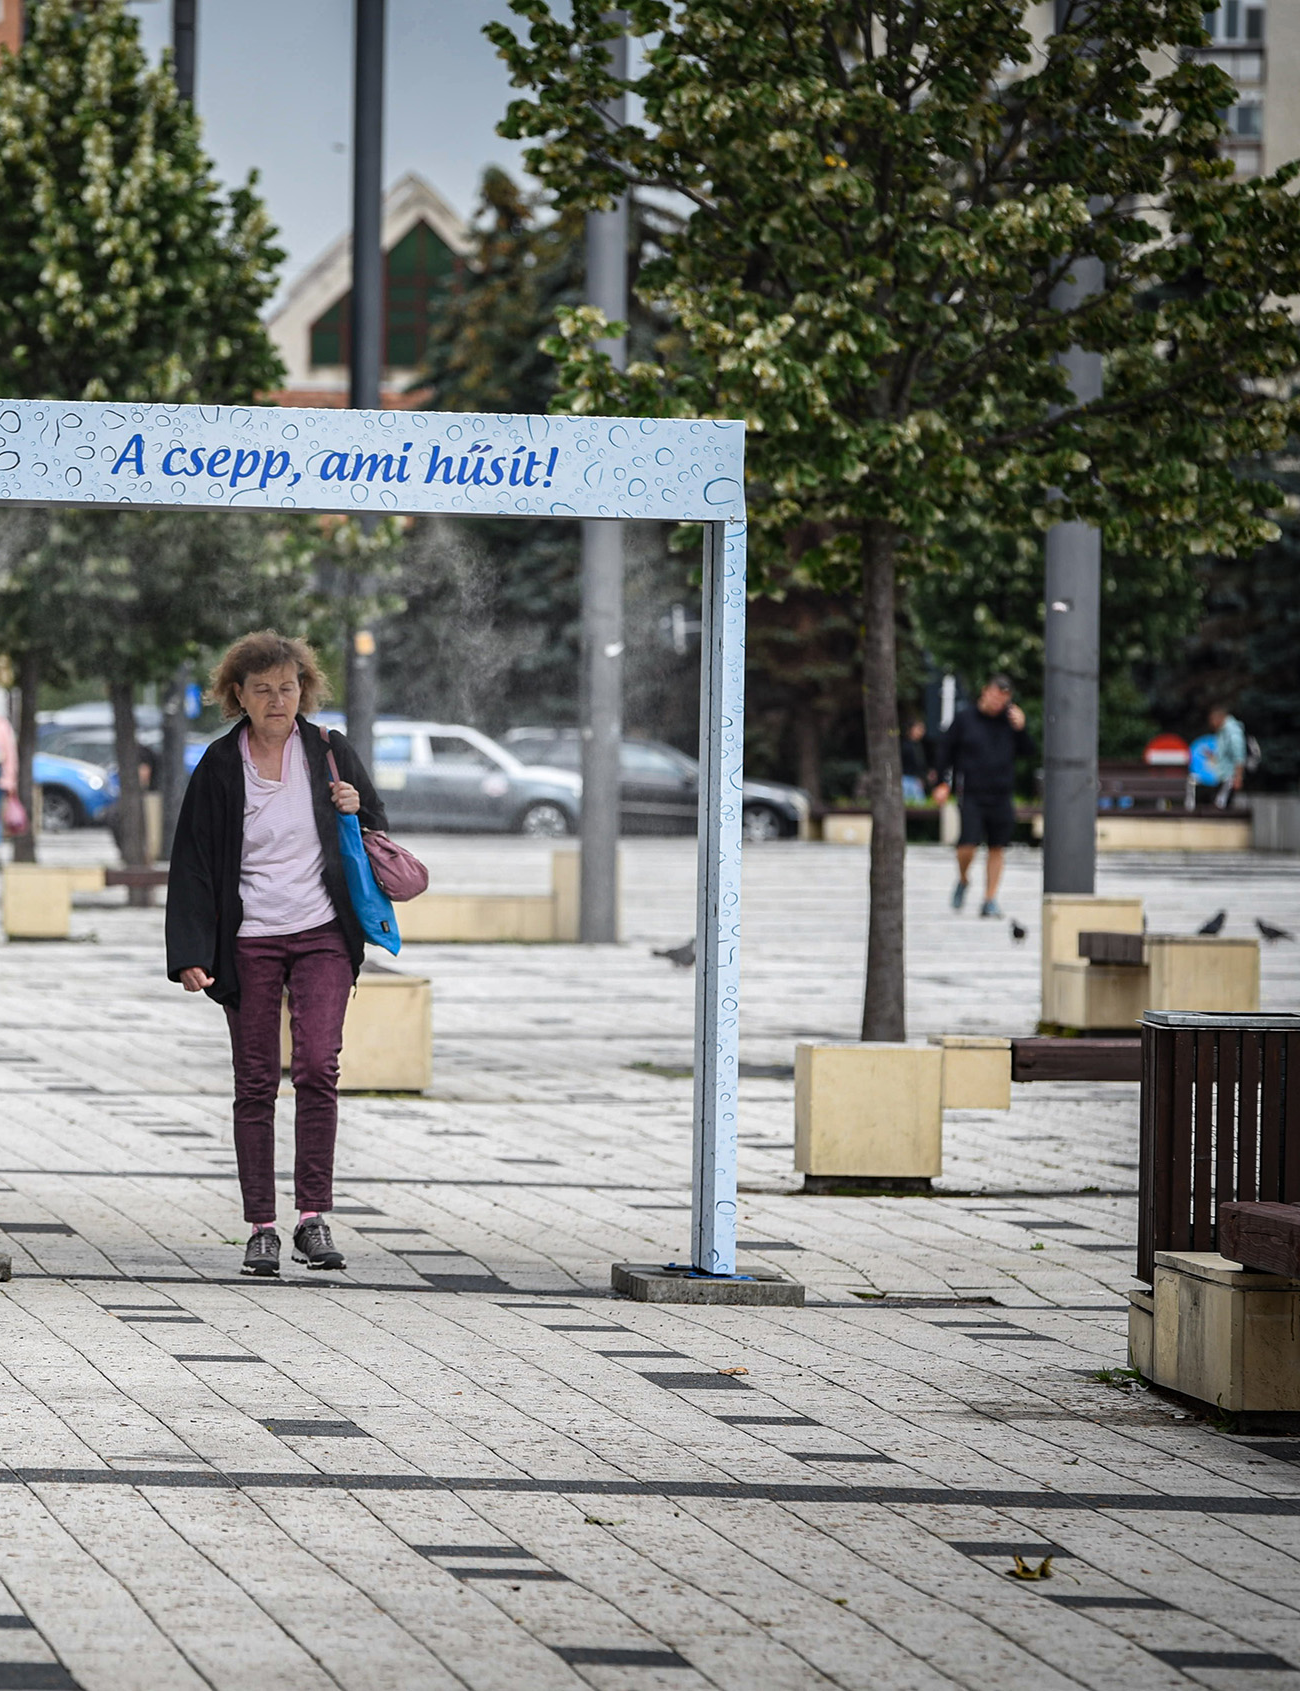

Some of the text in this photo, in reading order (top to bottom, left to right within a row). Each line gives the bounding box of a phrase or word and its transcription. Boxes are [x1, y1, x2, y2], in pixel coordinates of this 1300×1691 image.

[111, 433, 561, 490] A csepp, ami hűsít!
